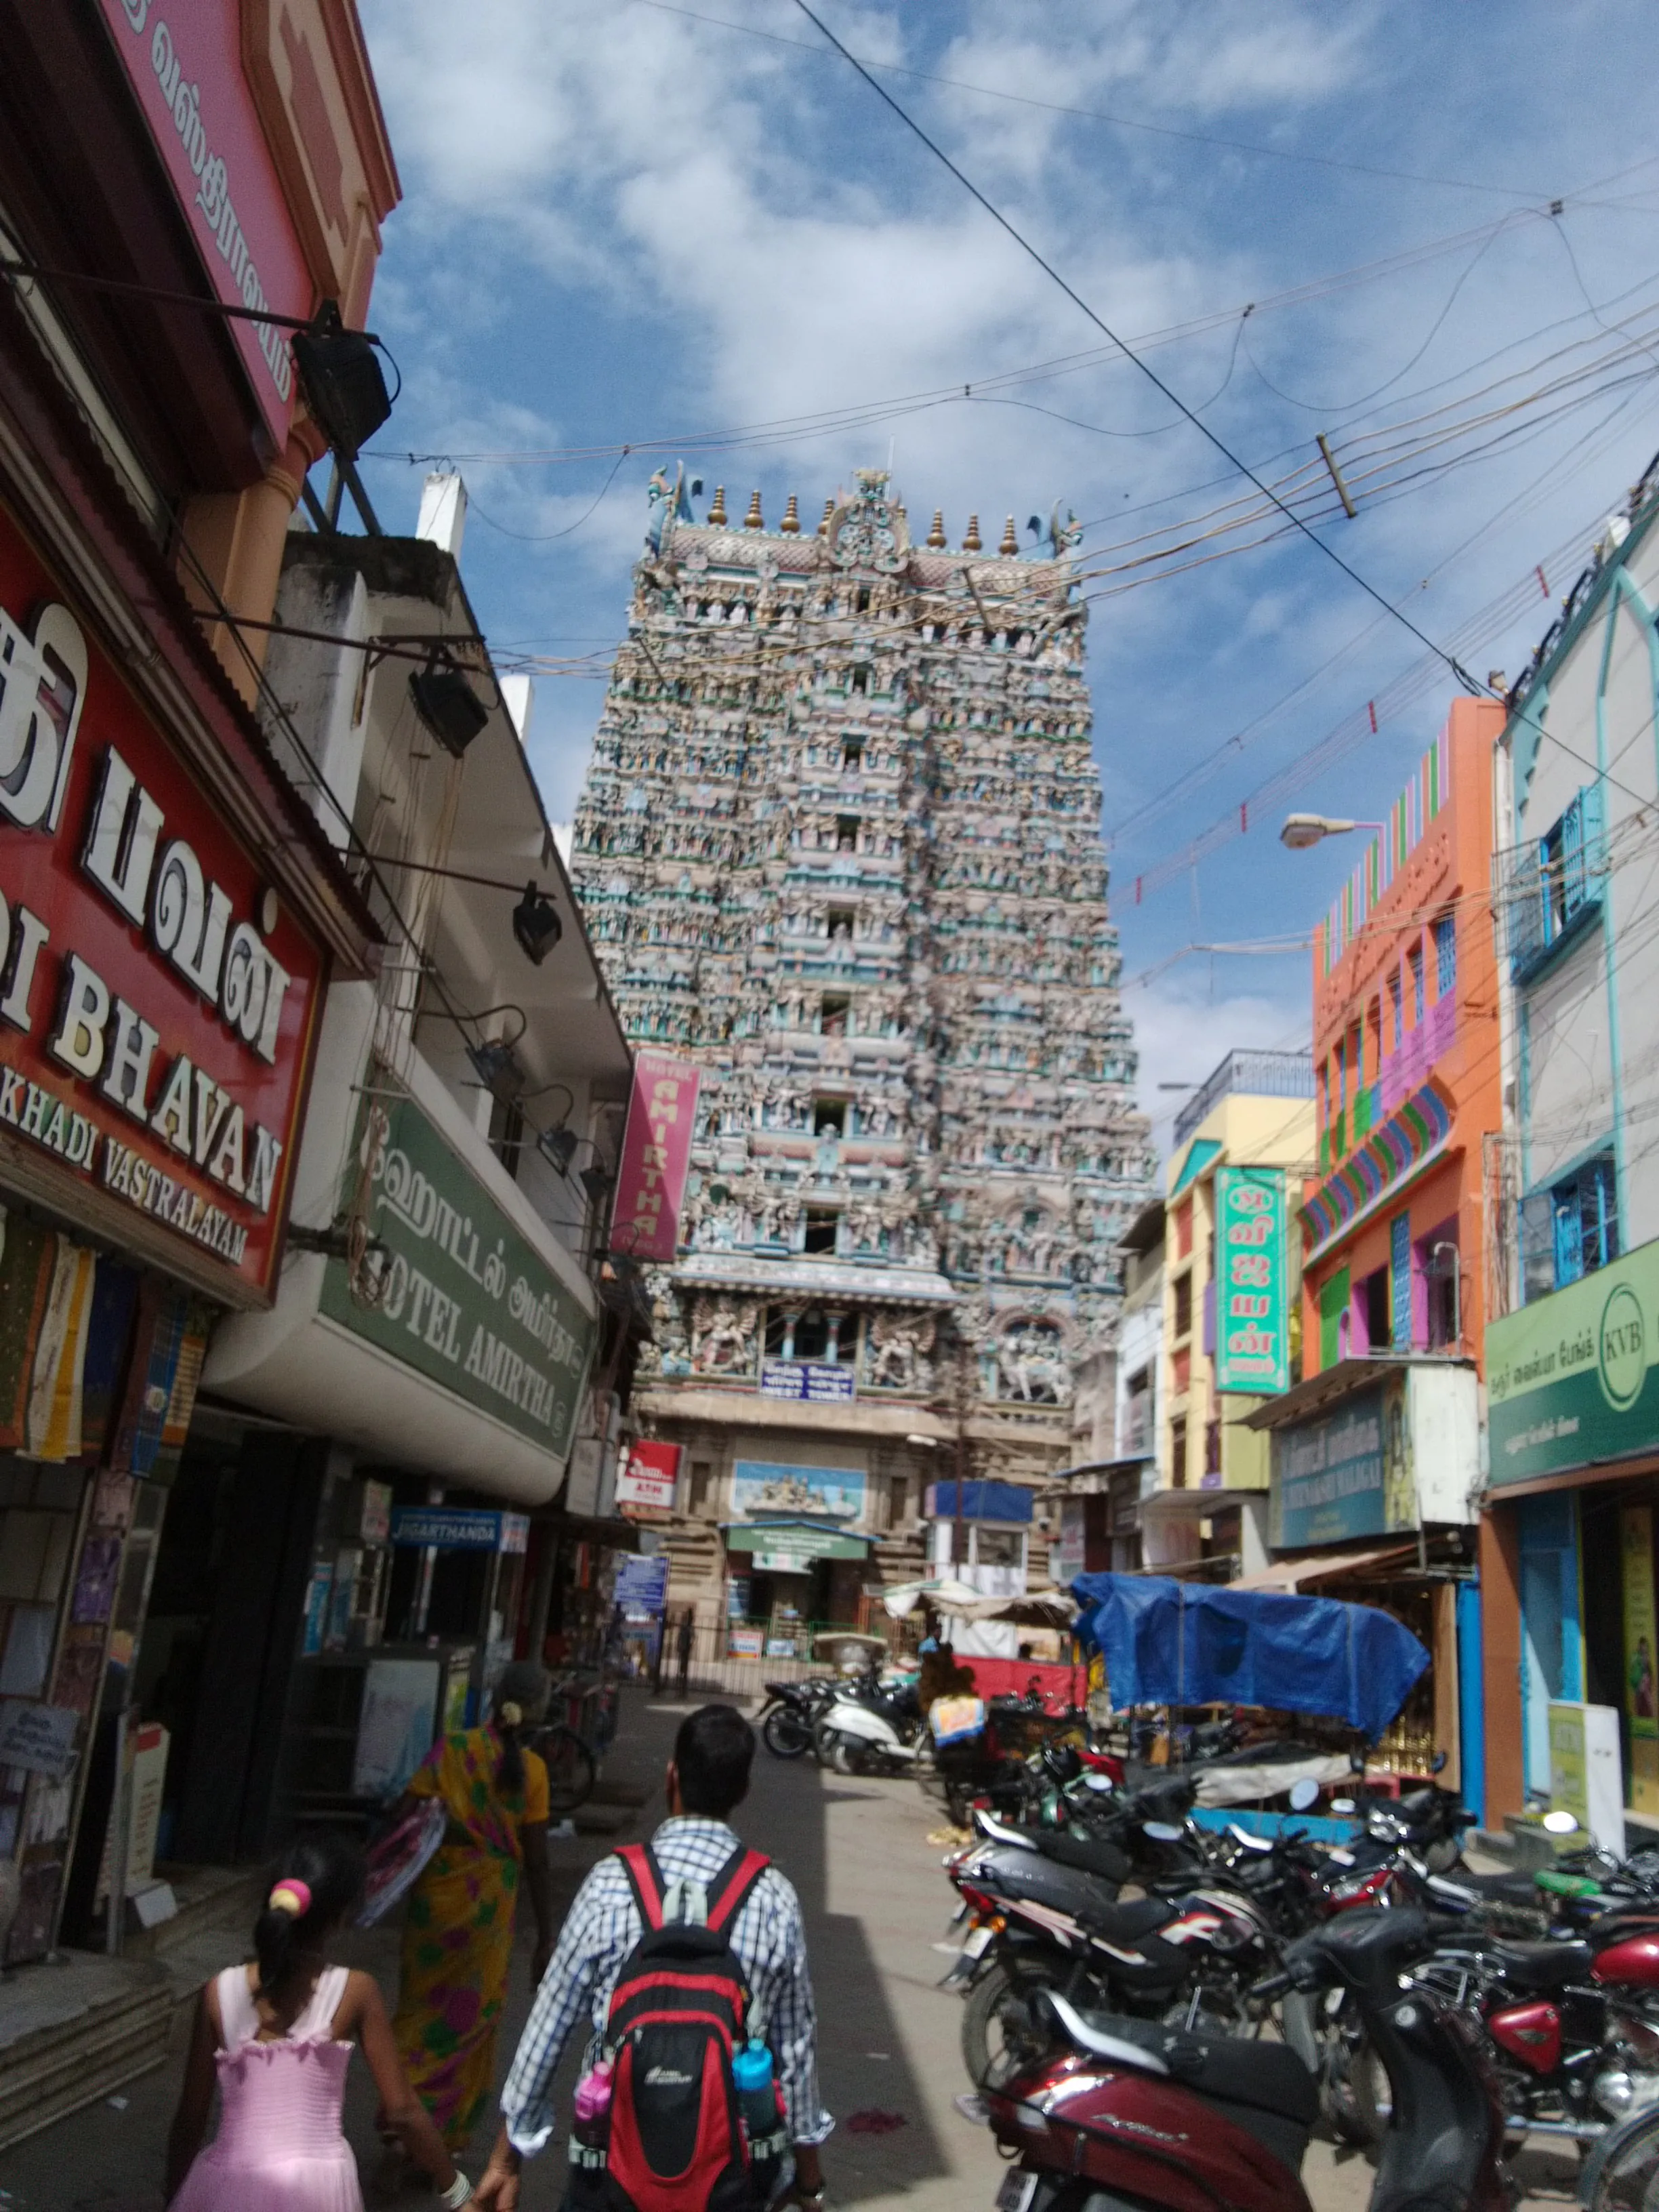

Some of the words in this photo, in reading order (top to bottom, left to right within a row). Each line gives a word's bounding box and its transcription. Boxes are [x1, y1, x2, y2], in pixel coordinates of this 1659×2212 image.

[83, 744, 291, 1065] பவன்
[0, 1067, 100, 1172] KHADI
[103, 1136, 248, 1265] VASTRALAYAM
[54, 952, 283, 1214] BHAVAN
[634, 1079, 678, 1237] AMIRTHA
[359, 1105, 506, 1299] ஹோட்டல்
[464, 1324, 555, 1427] AMIRTHA
[1605, 1320, 1642, 1363] KVB
